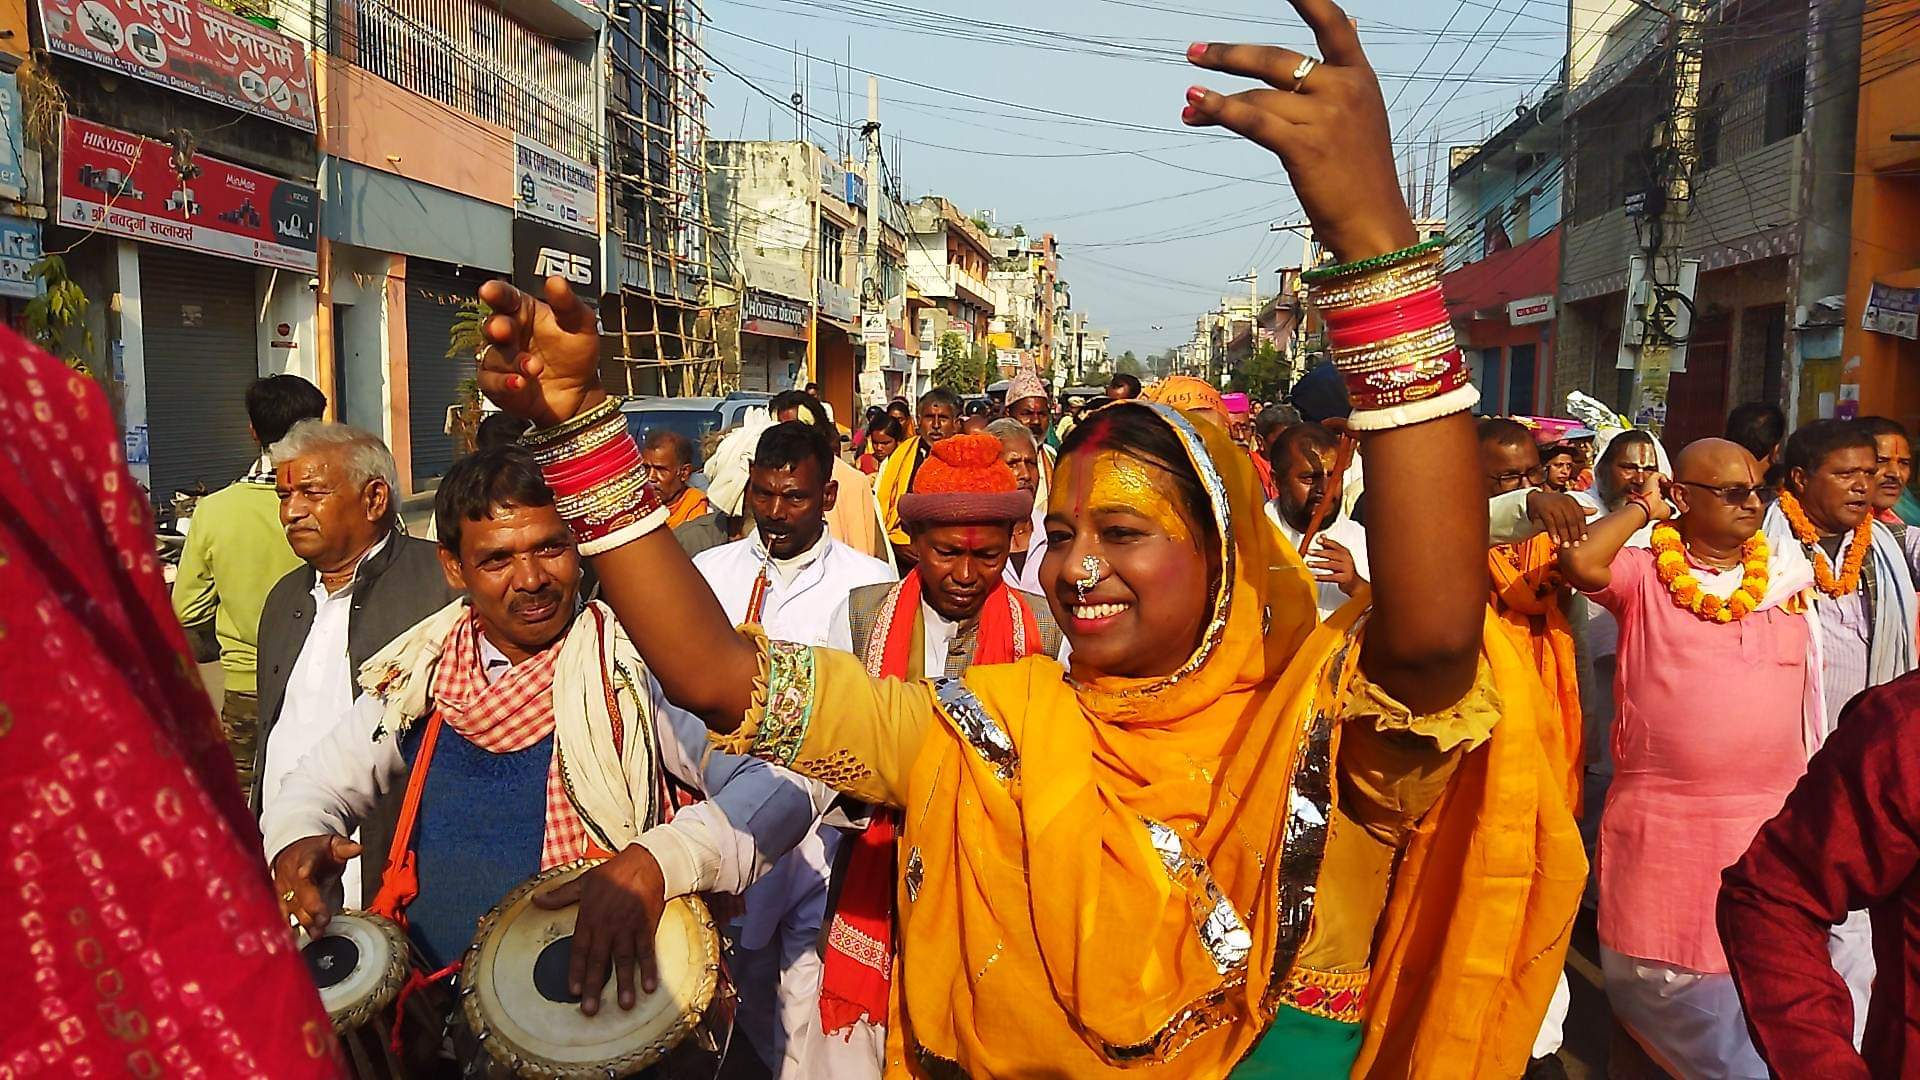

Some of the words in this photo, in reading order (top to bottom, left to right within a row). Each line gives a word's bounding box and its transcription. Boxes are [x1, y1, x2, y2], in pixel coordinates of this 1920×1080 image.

[51, 37, 66, 50] We
[68, 43, 93, 59] Deals
[93, 51, 113, 65] With
[83, 131, 143, 158] HIKVISION
[534, 247, 592, 285] ASUS
[749, 301, 778, 320] HOUSE
